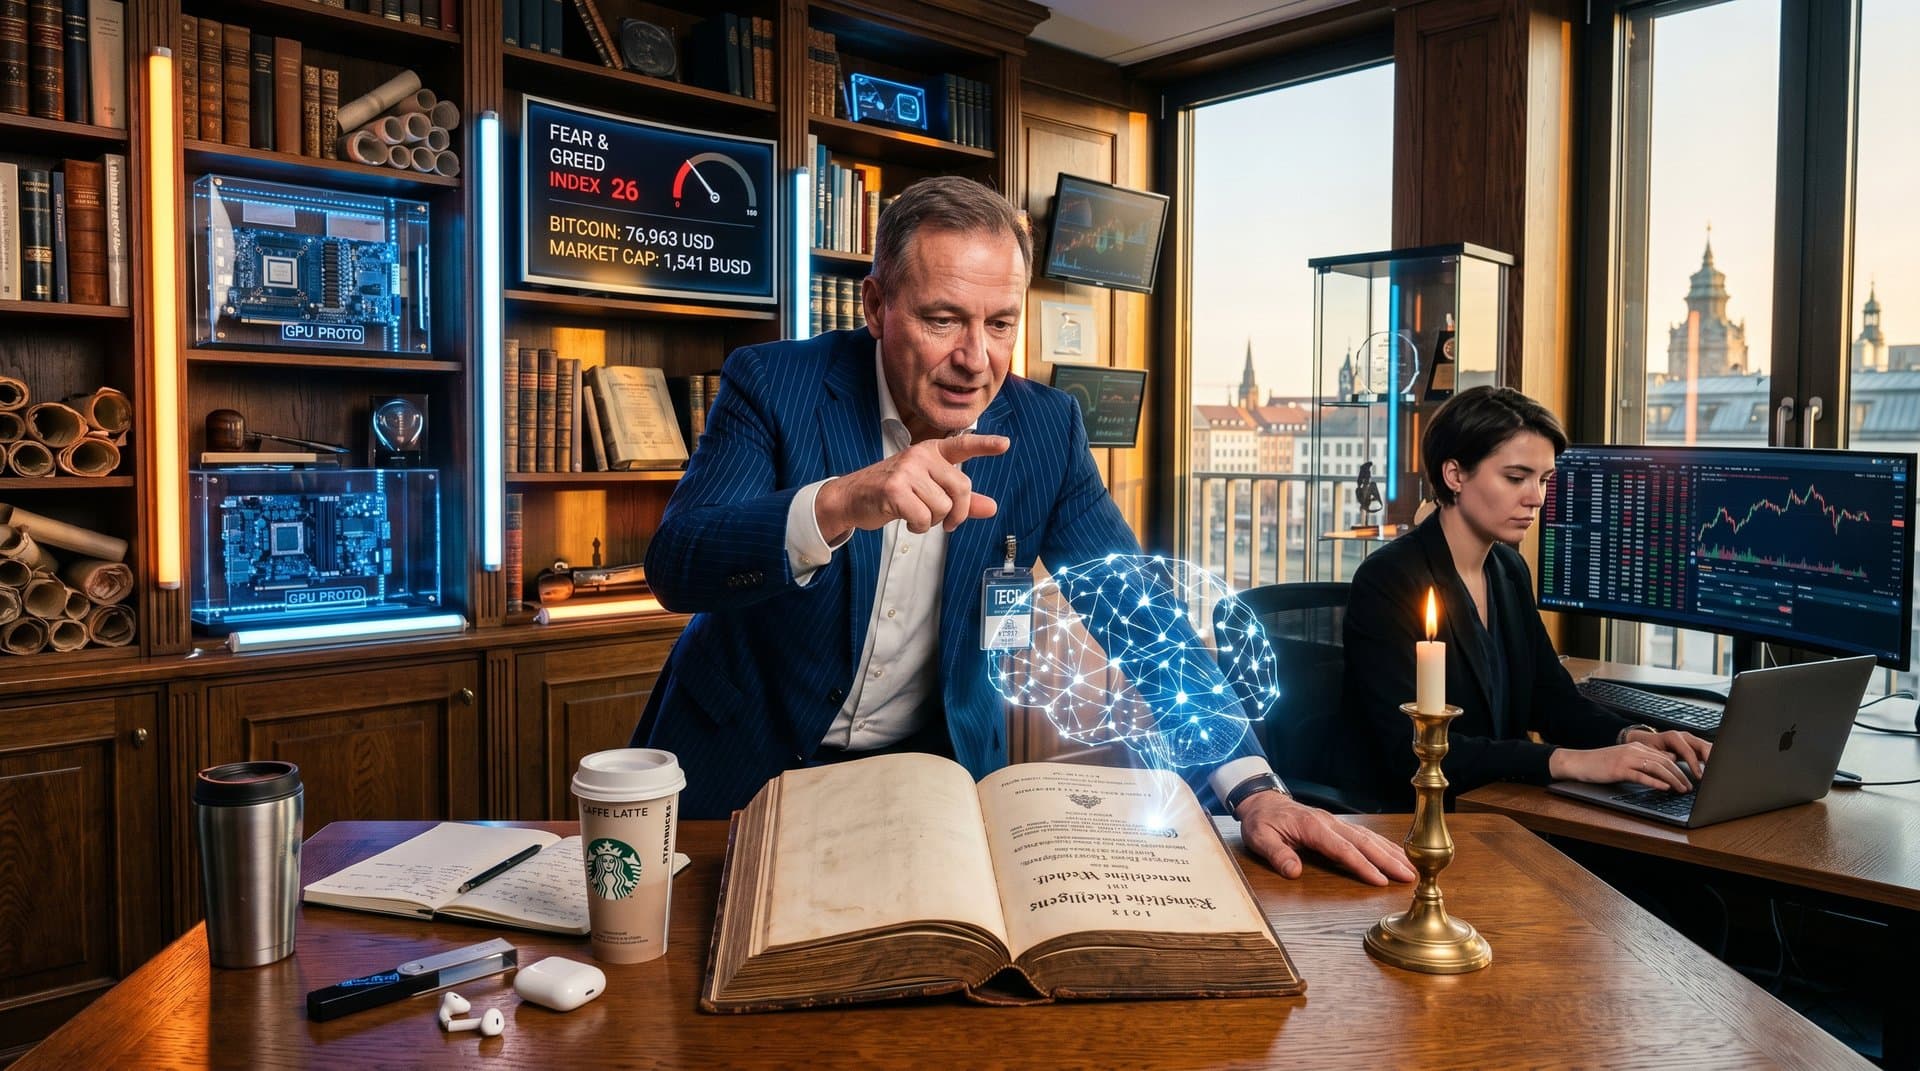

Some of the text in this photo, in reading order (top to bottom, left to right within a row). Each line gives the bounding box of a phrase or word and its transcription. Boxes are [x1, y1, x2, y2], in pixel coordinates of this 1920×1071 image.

[550, 124, 609, 150] FEAR &
[550, 148, 605, 172] GREED
[550, 171, 639, 201] INDEX 26
[550, 215, 714, 250] BITCOIN: 76,963 USD
[550, 239, 751, 275] MARKET CAP: 1,541 BUSD
[285, 325, 361, 340] GPU PROTO
[289, 589, 361, 604] GPU PROTO
[583, 804, 648, 818] CAFFE LATTE
[663, 804, 672, 865] STARBUCKS
